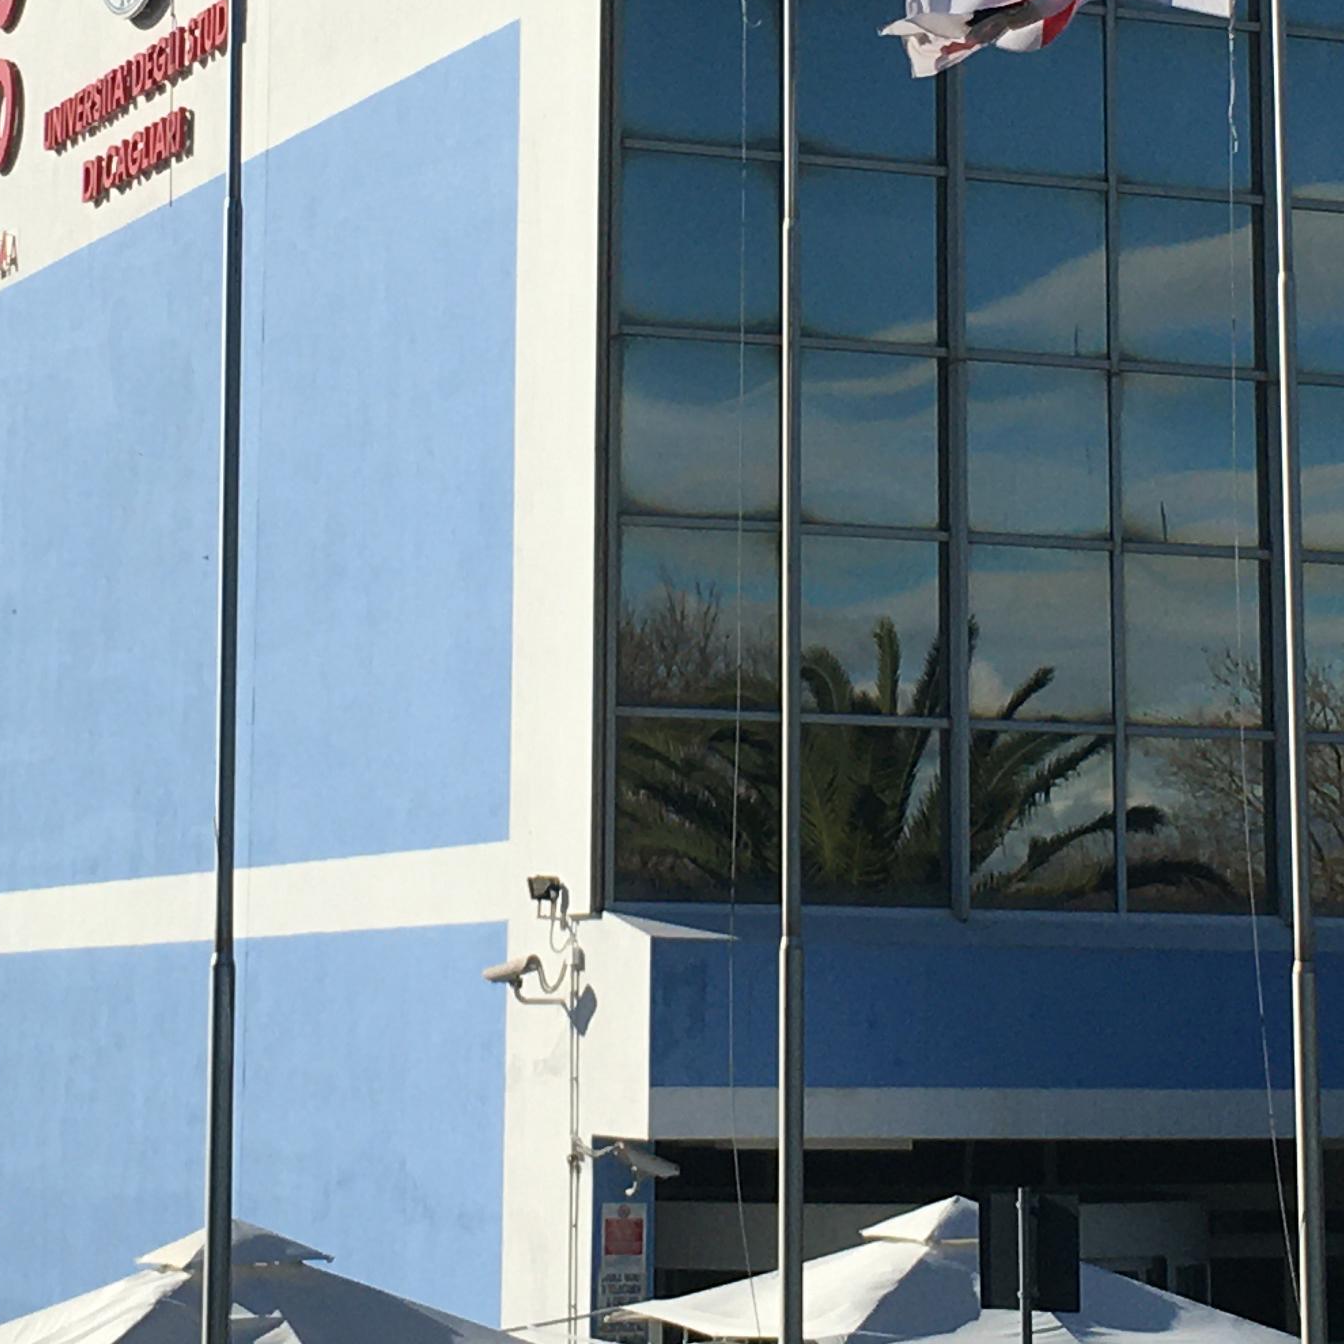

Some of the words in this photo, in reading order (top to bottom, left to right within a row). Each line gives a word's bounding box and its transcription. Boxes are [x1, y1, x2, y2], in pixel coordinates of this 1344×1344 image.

[132, 26, 186, 97] DEGLI
[188, 0, 230, 63] STUD
[82, 156, 105, 203] DI
[103, 106, 188, 189] CAGLIARI
